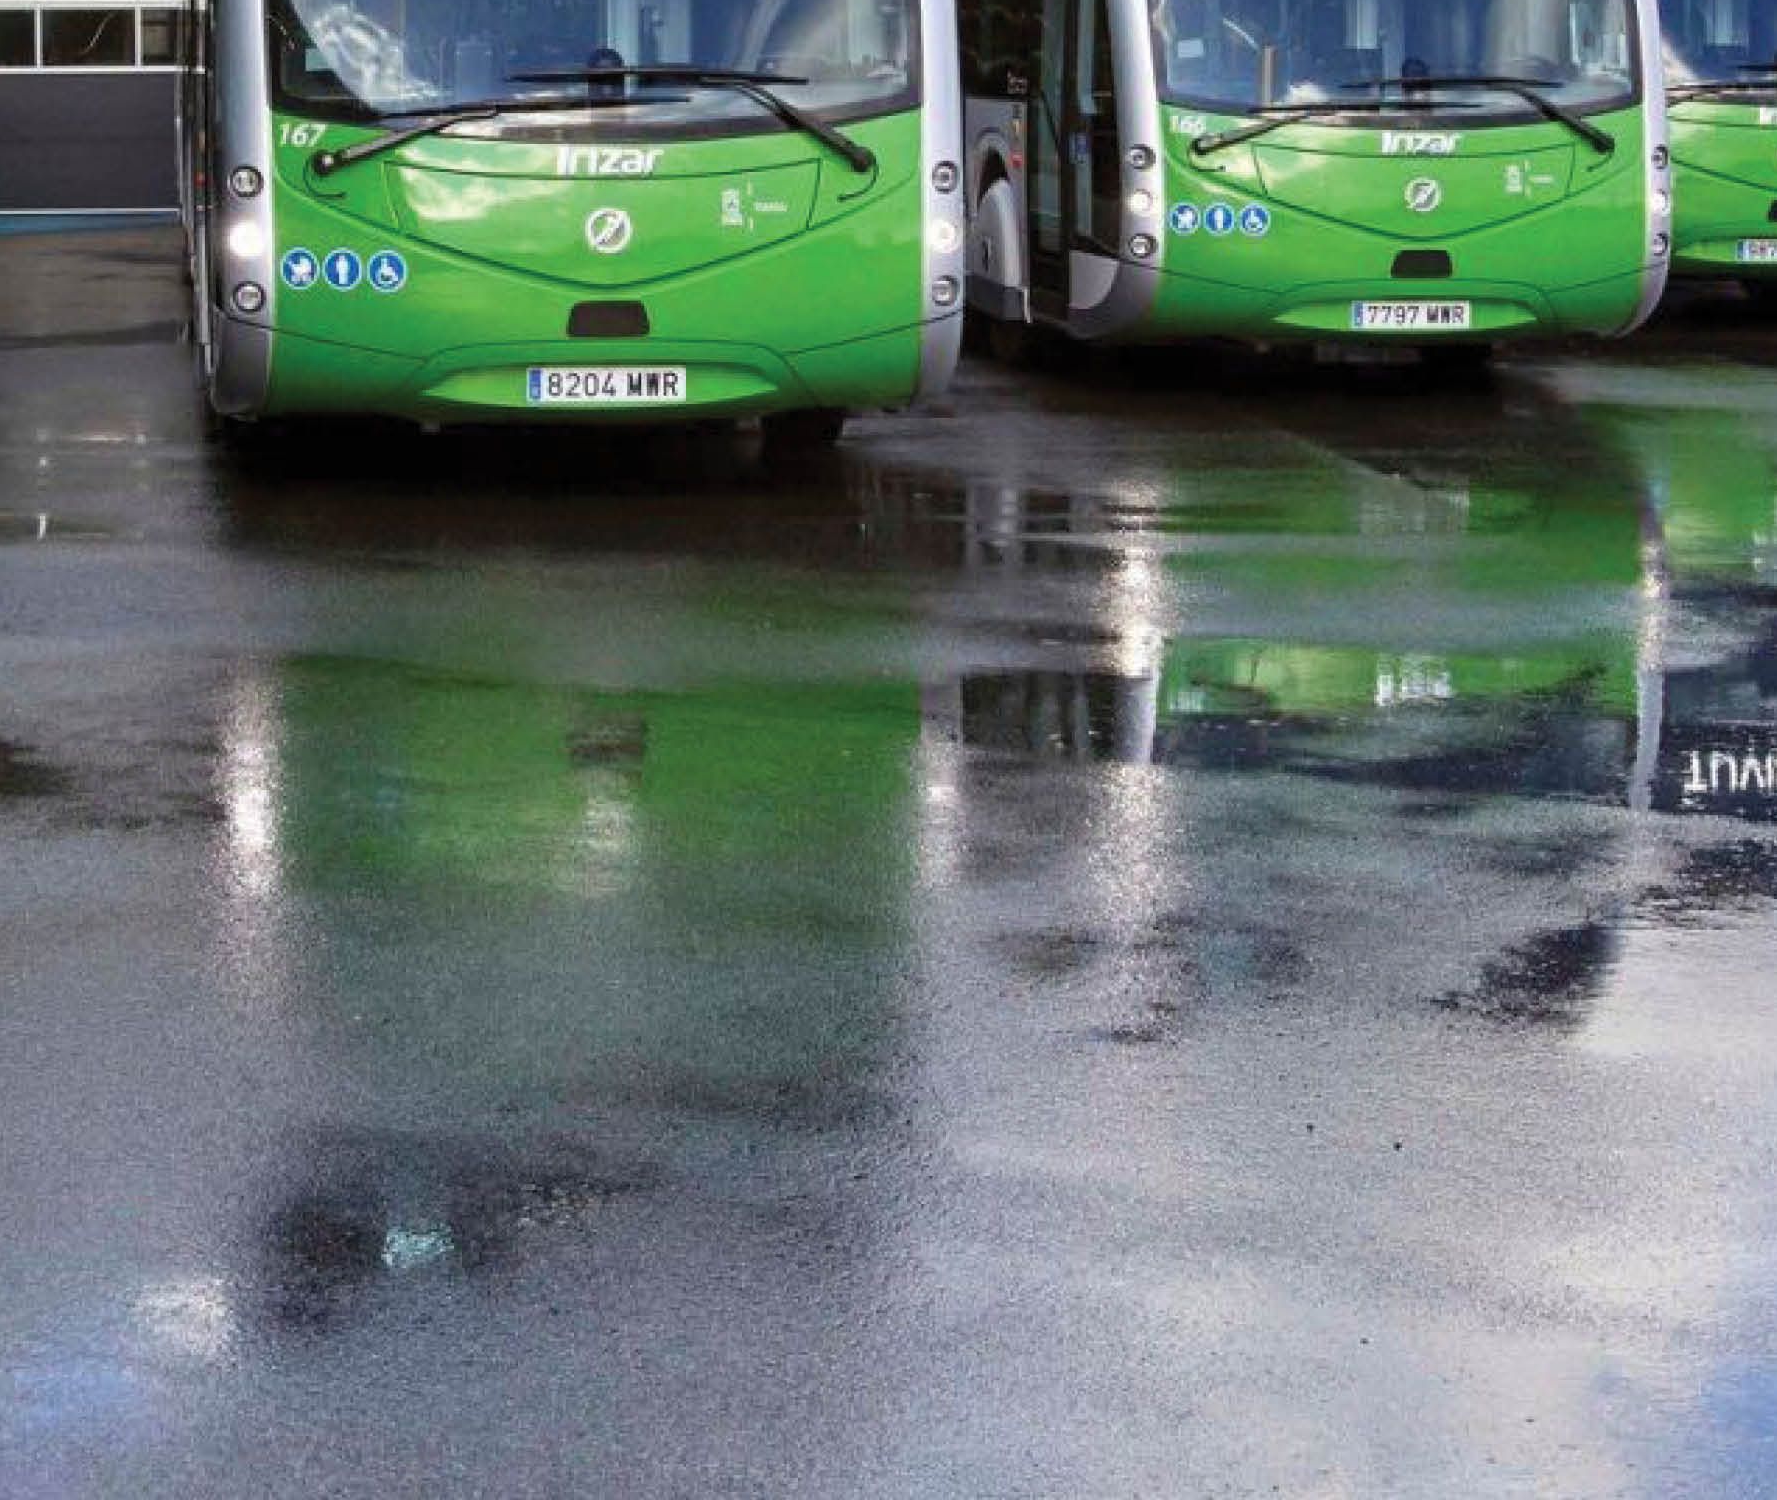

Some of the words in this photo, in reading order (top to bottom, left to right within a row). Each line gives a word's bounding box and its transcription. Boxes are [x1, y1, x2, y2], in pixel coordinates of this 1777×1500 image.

[277, 122, 327, 148] 167
[1367, 305, 1420, 324] 7797
[548, 372, 617, 397] 8204
[626, 372, 679, 397] MWR
